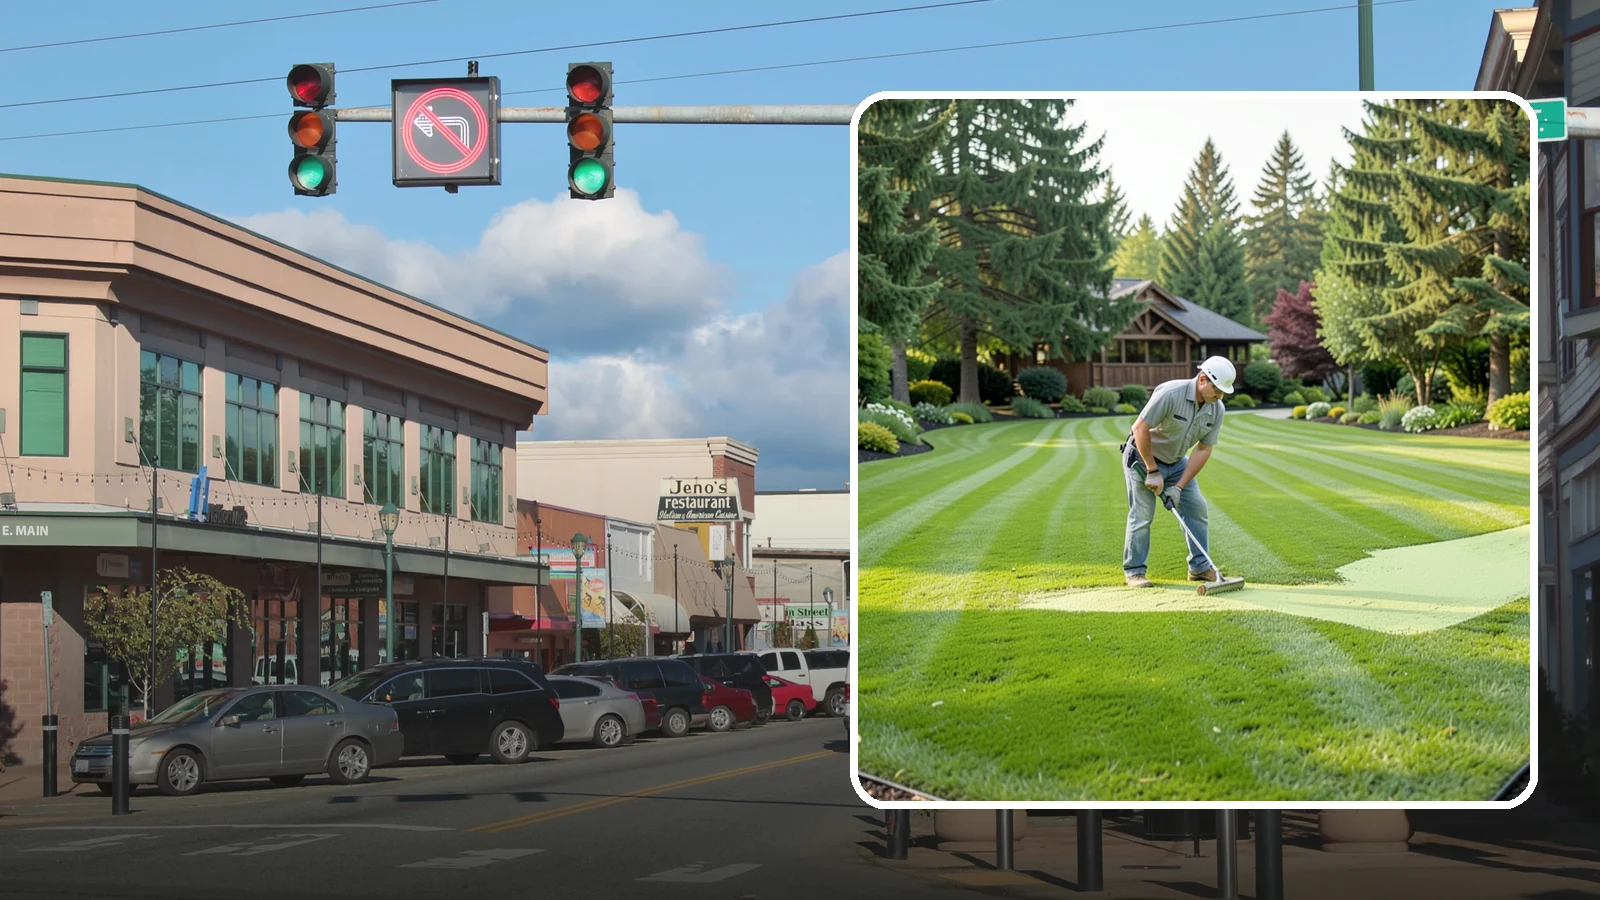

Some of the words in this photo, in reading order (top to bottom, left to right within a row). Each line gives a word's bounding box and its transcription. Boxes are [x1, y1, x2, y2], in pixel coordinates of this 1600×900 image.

[669, 480, 728, 494] Jeno's
[665, 496, 731, 509] restaurant
[715, 509, 738, 519] Cuisine
[2, 525, 13, 536] E.
[15, 525, 49, 536] MAIN
[797, 607, 829, 616] Street
